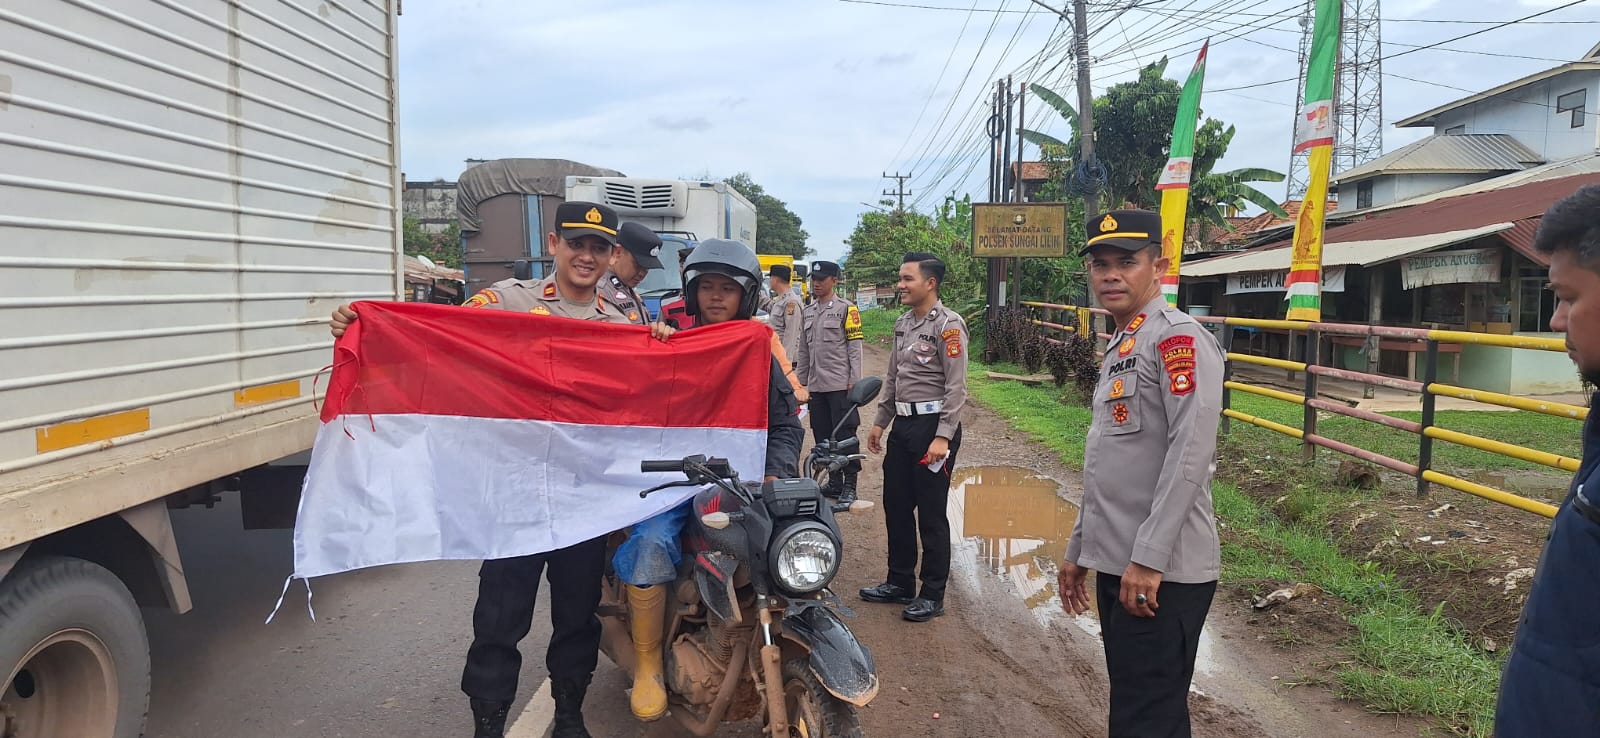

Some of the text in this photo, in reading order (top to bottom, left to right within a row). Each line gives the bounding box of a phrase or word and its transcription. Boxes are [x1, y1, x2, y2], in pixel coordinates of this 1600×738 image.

[978, 235, 1059, 248] POLSEK SUNGAI LILIN
[1408, 255, 1448, 271] PEMPEK
[1239, 272, 1273, 289] PEMPEK
[918, 333, 936, 344] POLRI
[1164, 348, 1193, 359] POLRES
[1108, 357, 1137, 376] POLRI
